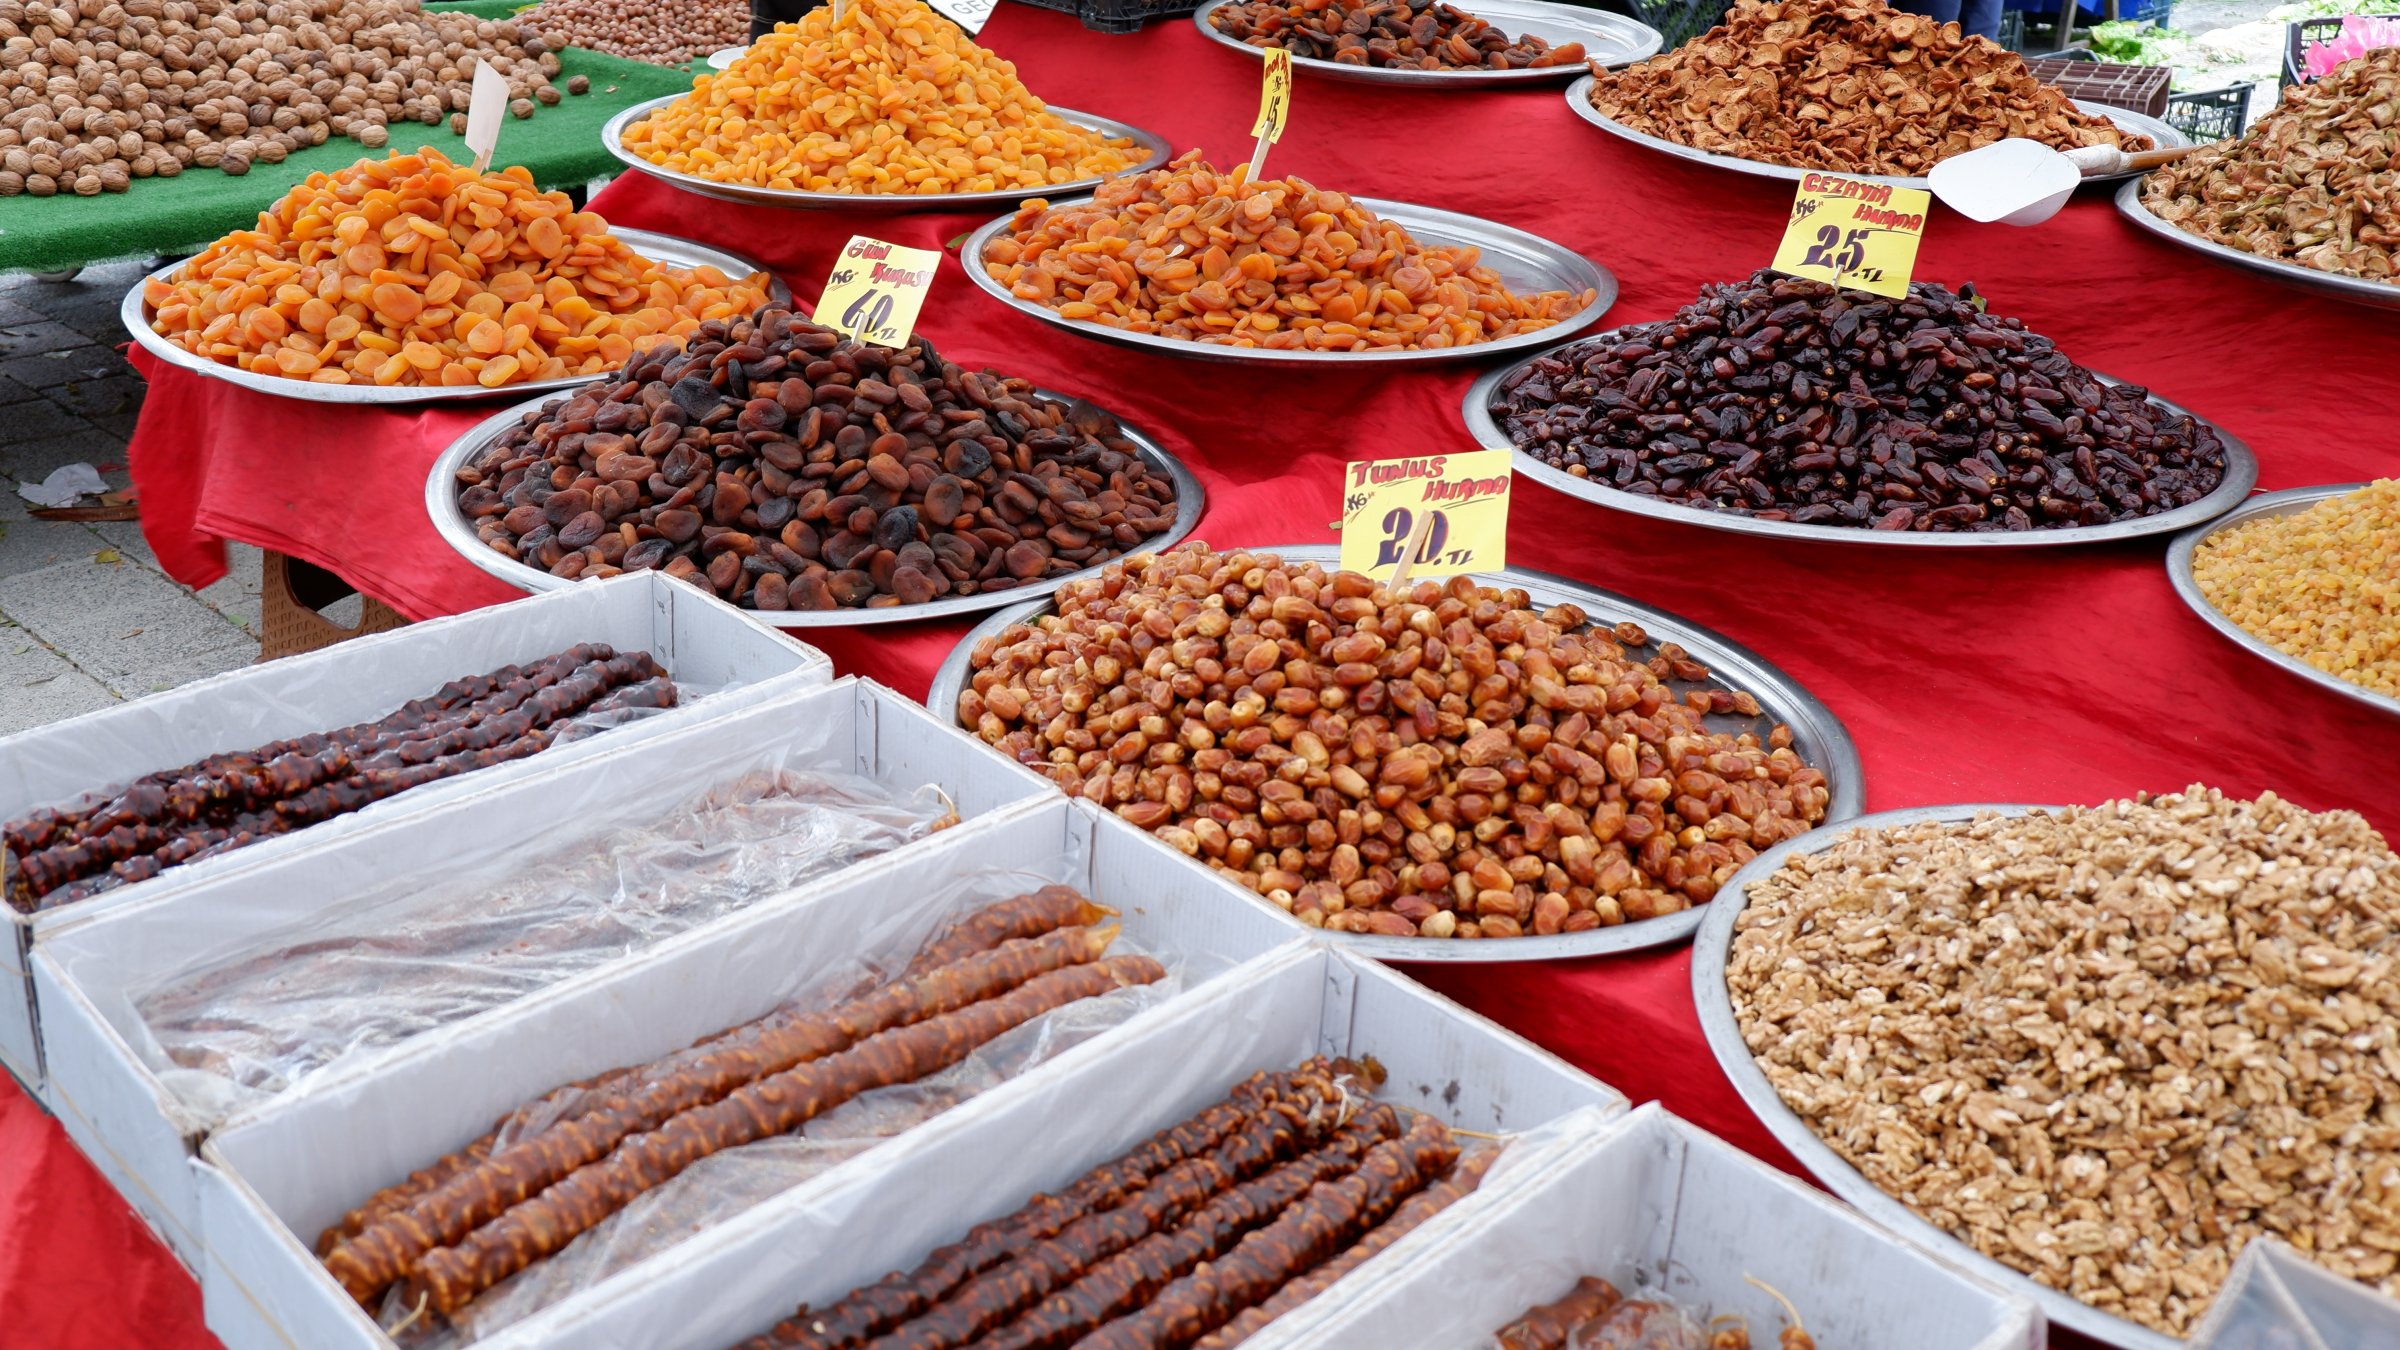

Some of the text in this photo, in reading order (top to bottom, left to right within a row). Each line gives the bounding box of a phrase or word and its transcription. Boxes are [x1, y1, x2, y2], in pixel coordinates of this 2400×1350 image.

[951, 0, 993, 14] GE
[1852, 204, 1923, 231] HURMA
[847, 240, 892, 260] GÜN
[1351, 456, 1447, 488] TUNUS
[1421, 475, 1509, 502] HURMA
